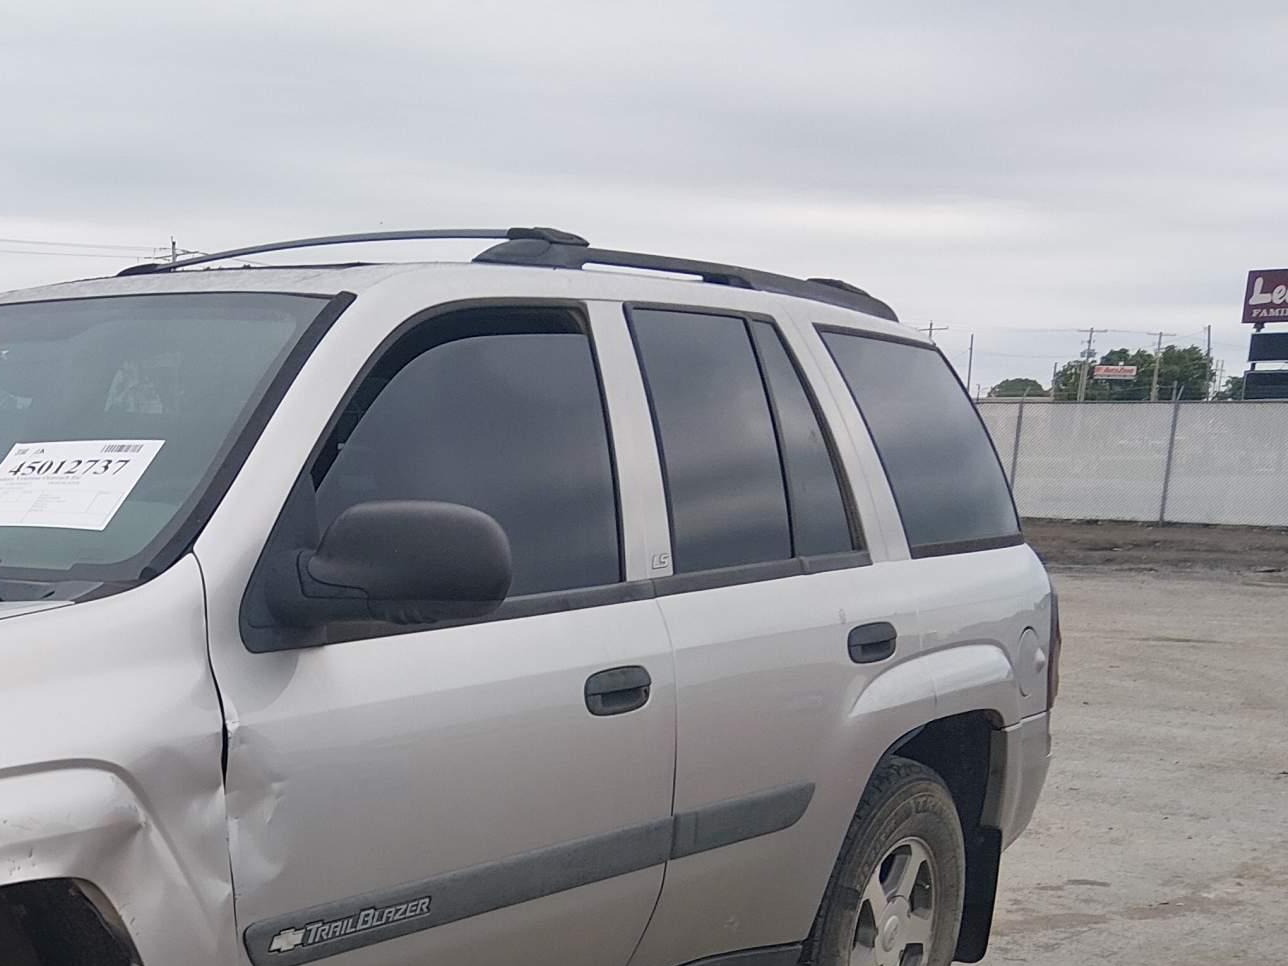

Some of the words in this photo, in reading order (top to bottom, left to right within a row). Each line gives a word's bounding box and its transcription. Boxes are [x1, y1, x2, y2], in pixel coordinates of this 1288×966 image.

[1249, 276, 1288, 305] Le
[8, 459, 130, 476] 45012737
[652, 552, 669, 569] LS
